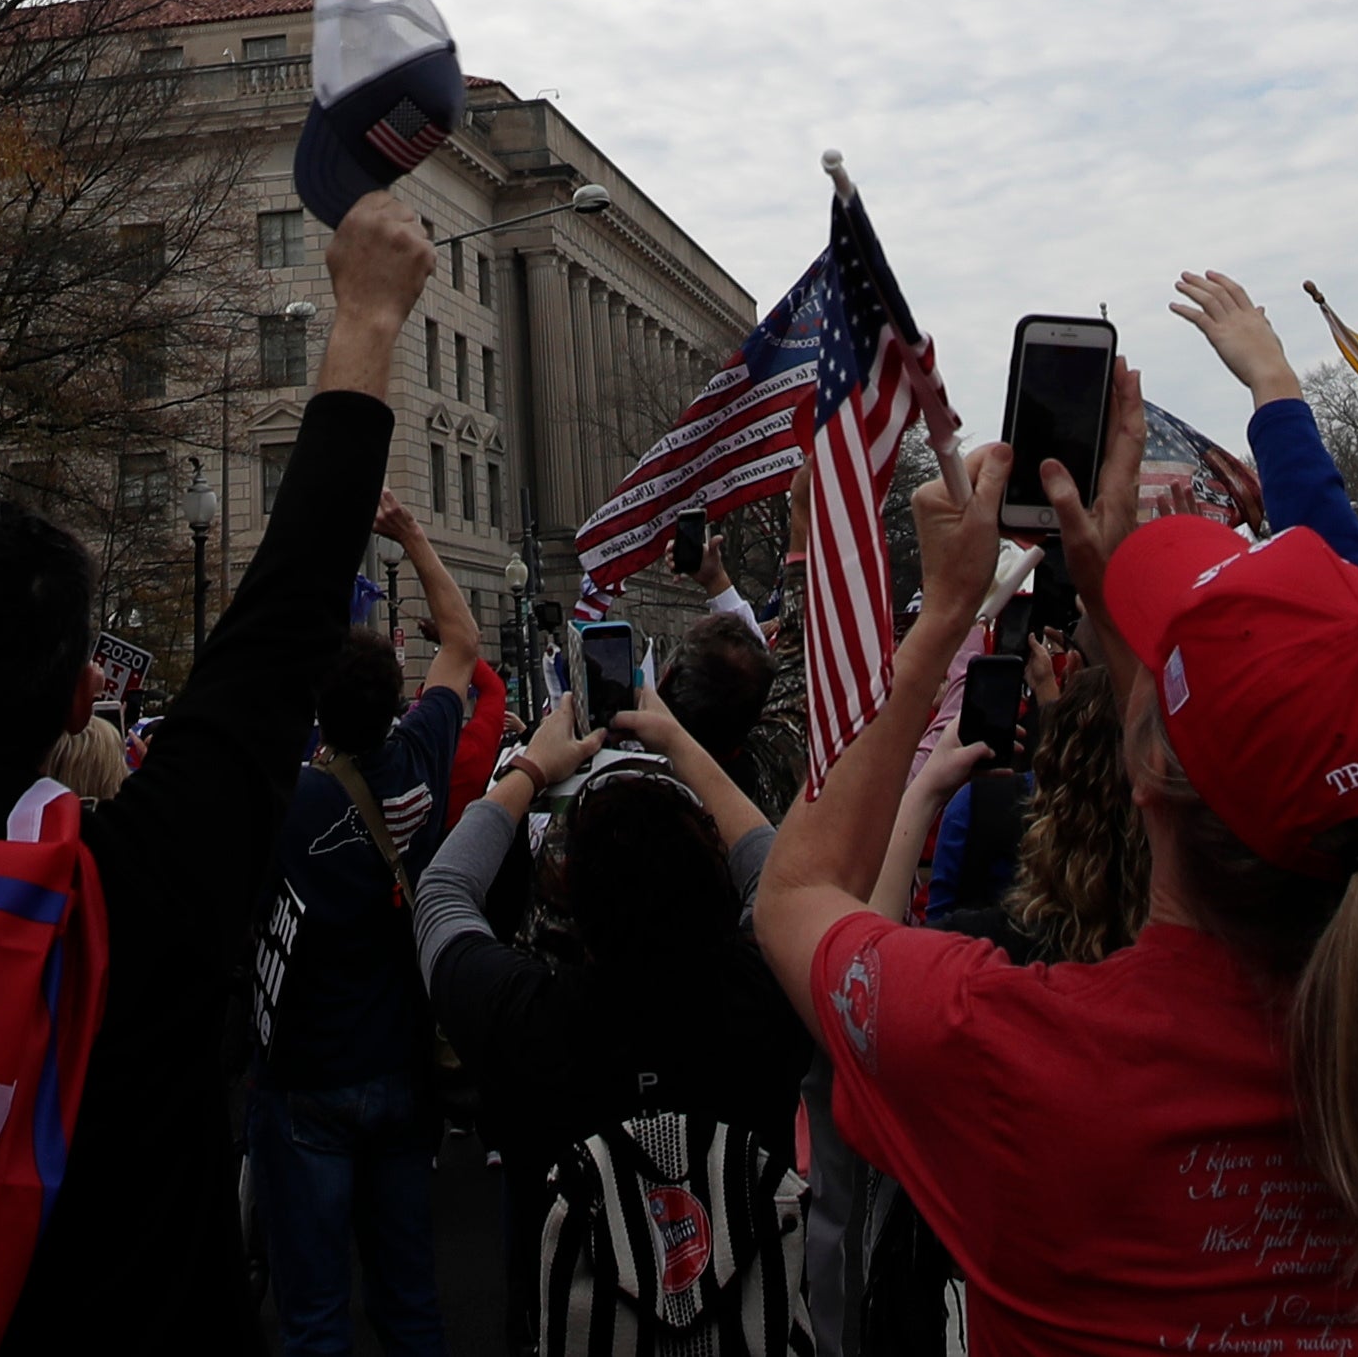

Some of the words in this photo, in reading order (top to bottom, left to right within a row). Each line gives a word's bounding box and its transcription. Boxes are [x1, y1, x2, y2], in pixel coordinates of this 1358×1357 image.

[100, 639, 145, 670] 2020
[1206, 1140, 1255, 1174] believe
[1264, 1153, 1284, 1168] in
[1237, 1182, 1251, 1197] a
[1253, 1195, 1306, 1235] people
[1200, 1222, 1253, 1255] Whose
[1254, 1220, 1300, 1268] just
[1240, 1294, 1279, 1327] A
[1158, 1322, 1202, 1354] A
[1296, 1324, 1355, 1356] nation
